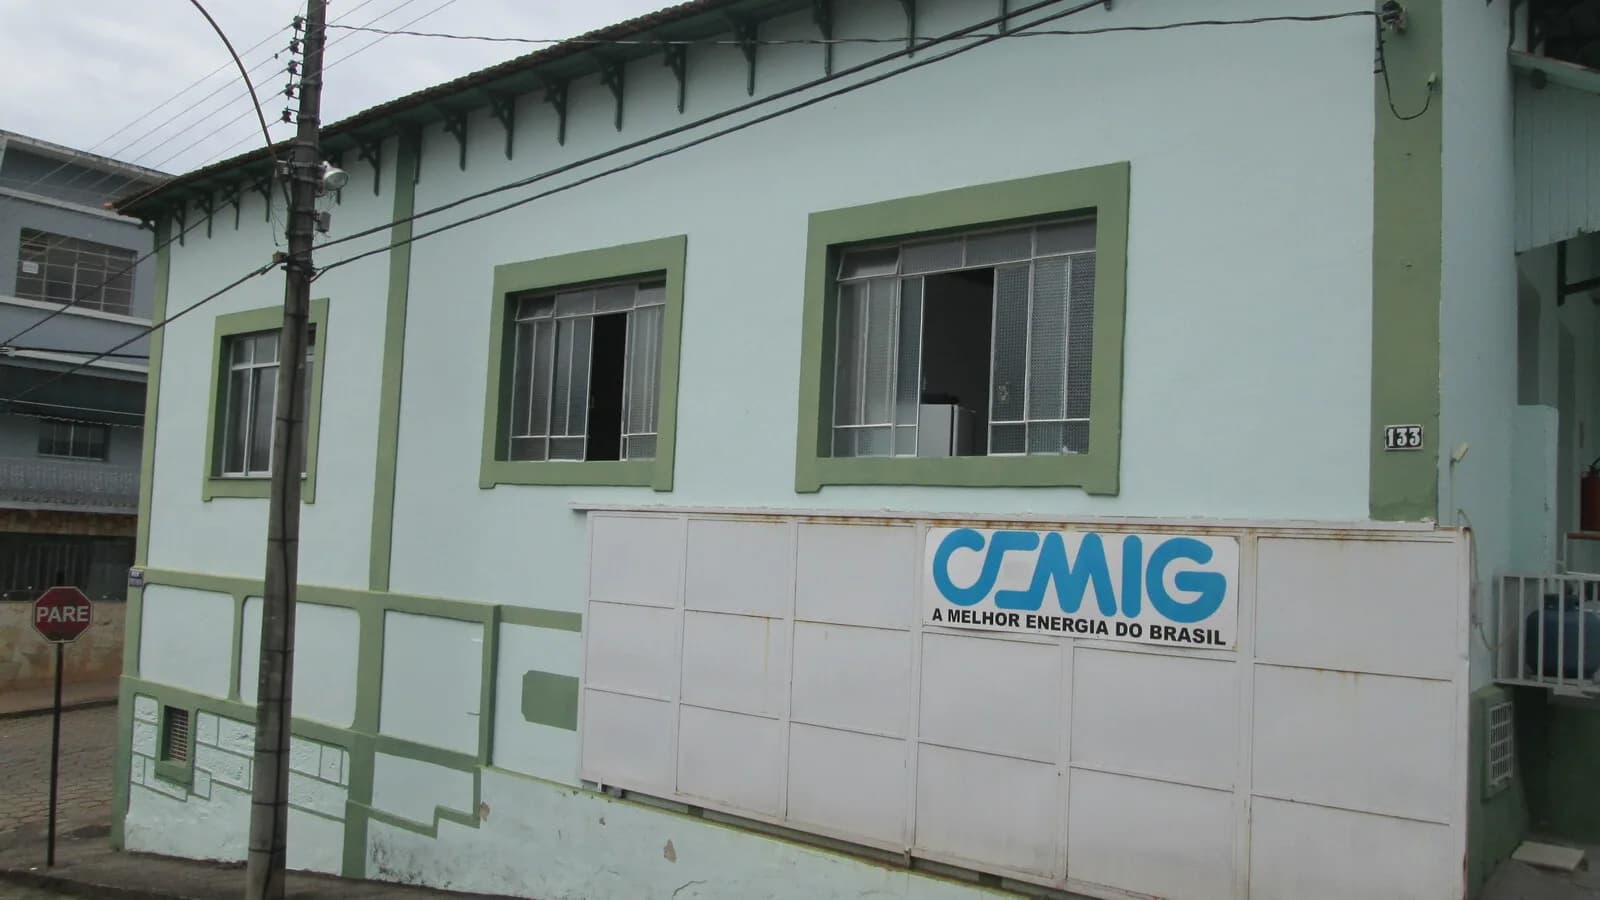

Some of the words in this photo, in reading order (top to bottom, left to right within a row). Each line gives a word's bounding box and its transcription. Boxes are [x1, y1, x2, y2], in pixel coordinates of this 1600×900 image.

[1388, 428, 1420, 447] 133
[933, 528, 1227, 623] CEMIG
[36, 606, 89, 623] PARE
[932, 608, 943, 622] A
[948, 609, 1020, 628] MELHOR
[1026, 615, 1109, 635] ENERGIA
[1115, 622, 1143, 638] DO
[1150, 625, 1226, 645] BRASIL
